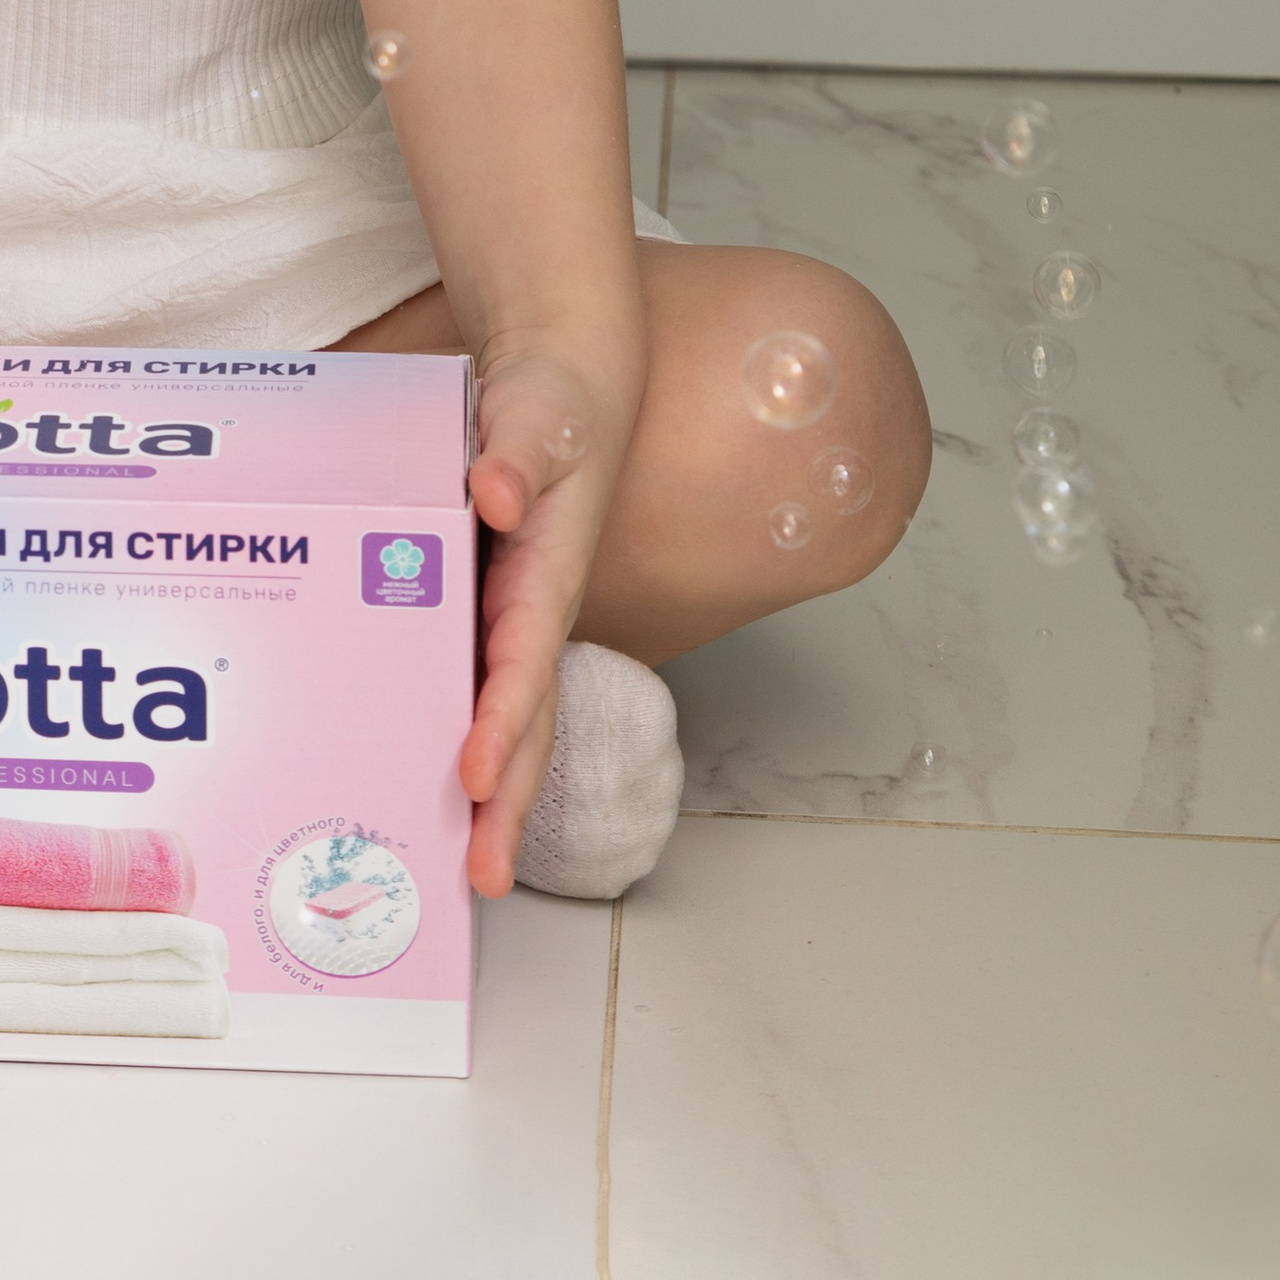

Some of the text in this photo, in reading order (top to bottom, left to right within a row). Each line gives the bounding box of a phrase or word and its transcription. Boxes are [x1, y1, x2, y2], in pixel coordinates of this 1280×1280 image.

[42, 359, 131, 375] ДЛЯ
[144, 361, 316, 376] СТИРКИ
[45, 381, 121, 390] пленке
[131, 382, 303, 393] универсальные
[20, 529, 113, 562] ДЛЯ
[126, 531, 309, 564] СТИРКИ
[25, 581, 106, 596] пленке
[115, 583, 297, 601] универсальные
[376, 588, 426, 596] цветочный
[382, 581, 419, 589] нежный
[385, 596, 418, 604] аромат
[273, 817, 345, 856] цветного
[257, 856, 276, 886] для
[254, 889, 264, 899] и
[281, 962, 312, 985] для
